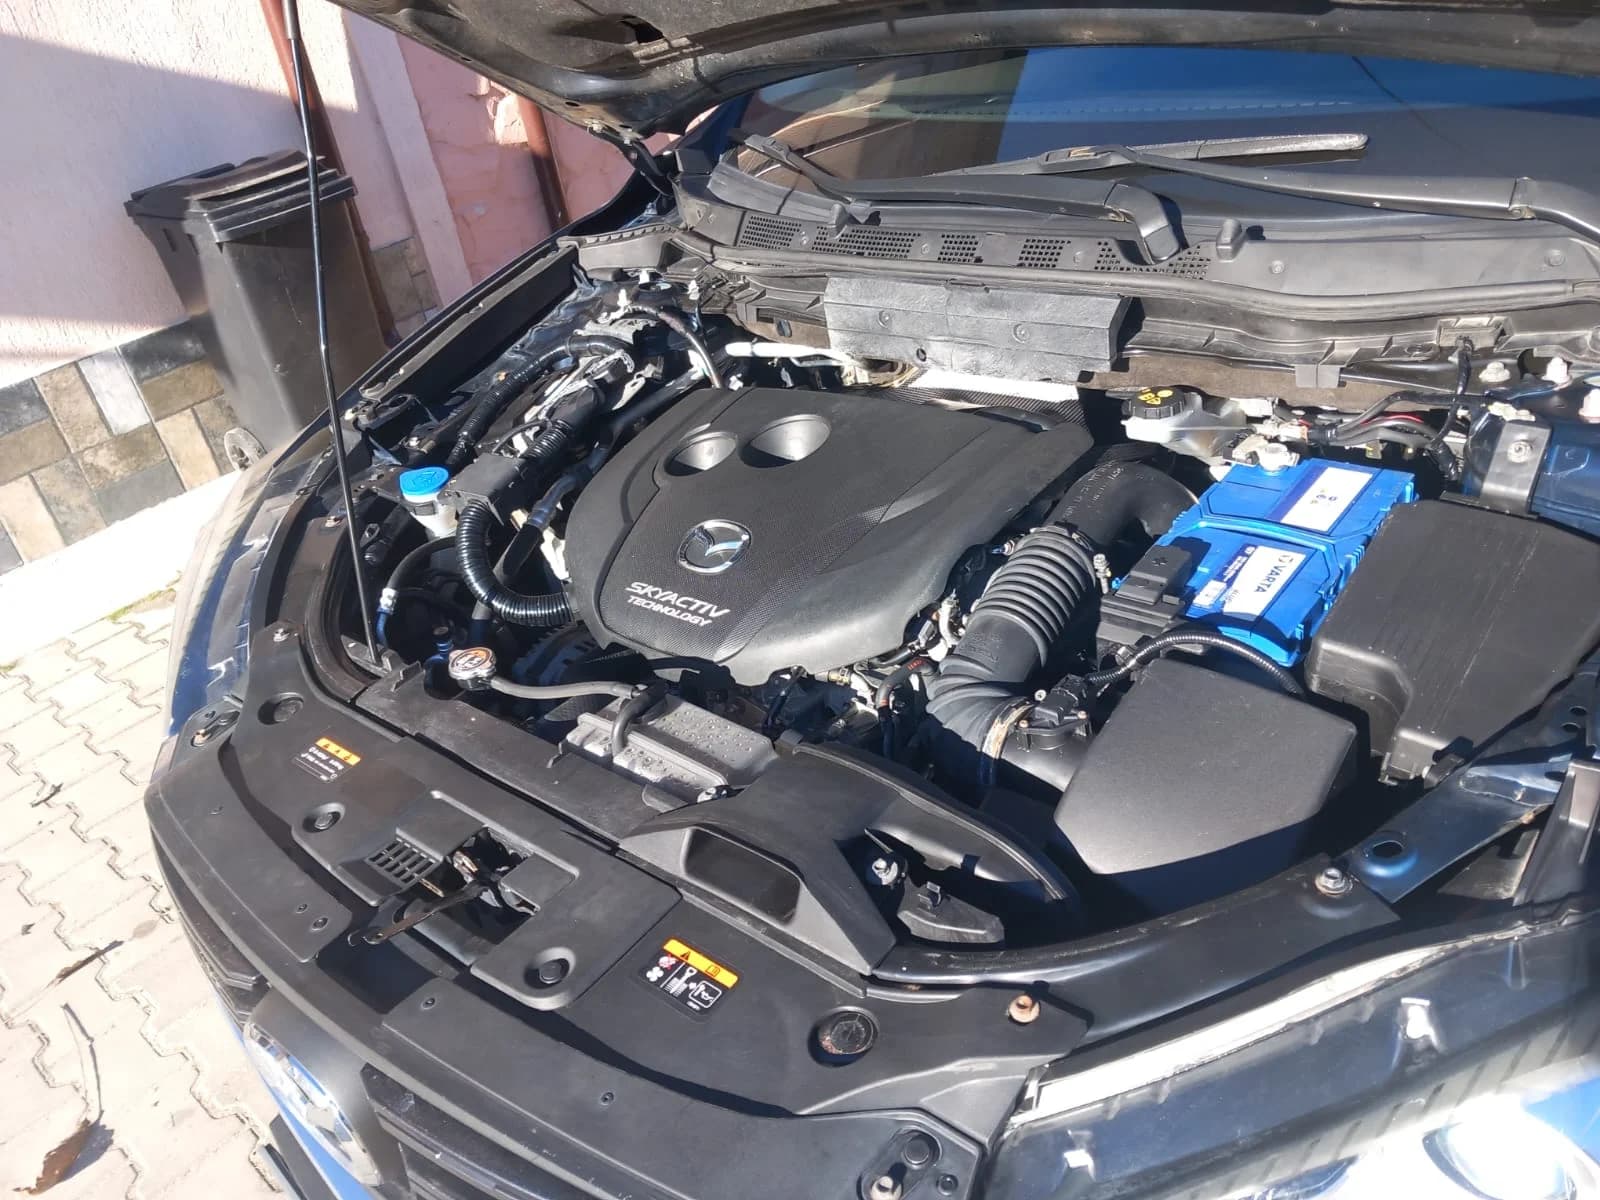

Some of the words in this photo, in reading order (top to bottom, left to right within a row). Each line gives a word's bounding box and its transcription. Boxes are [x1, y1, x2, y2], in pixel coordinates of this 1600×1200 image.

[1254, 565, 1288, 593] VARTA
[625, 581, 731, 618] SKYACTIV
[627, 595, 713, 627] TECHNOLOGY
